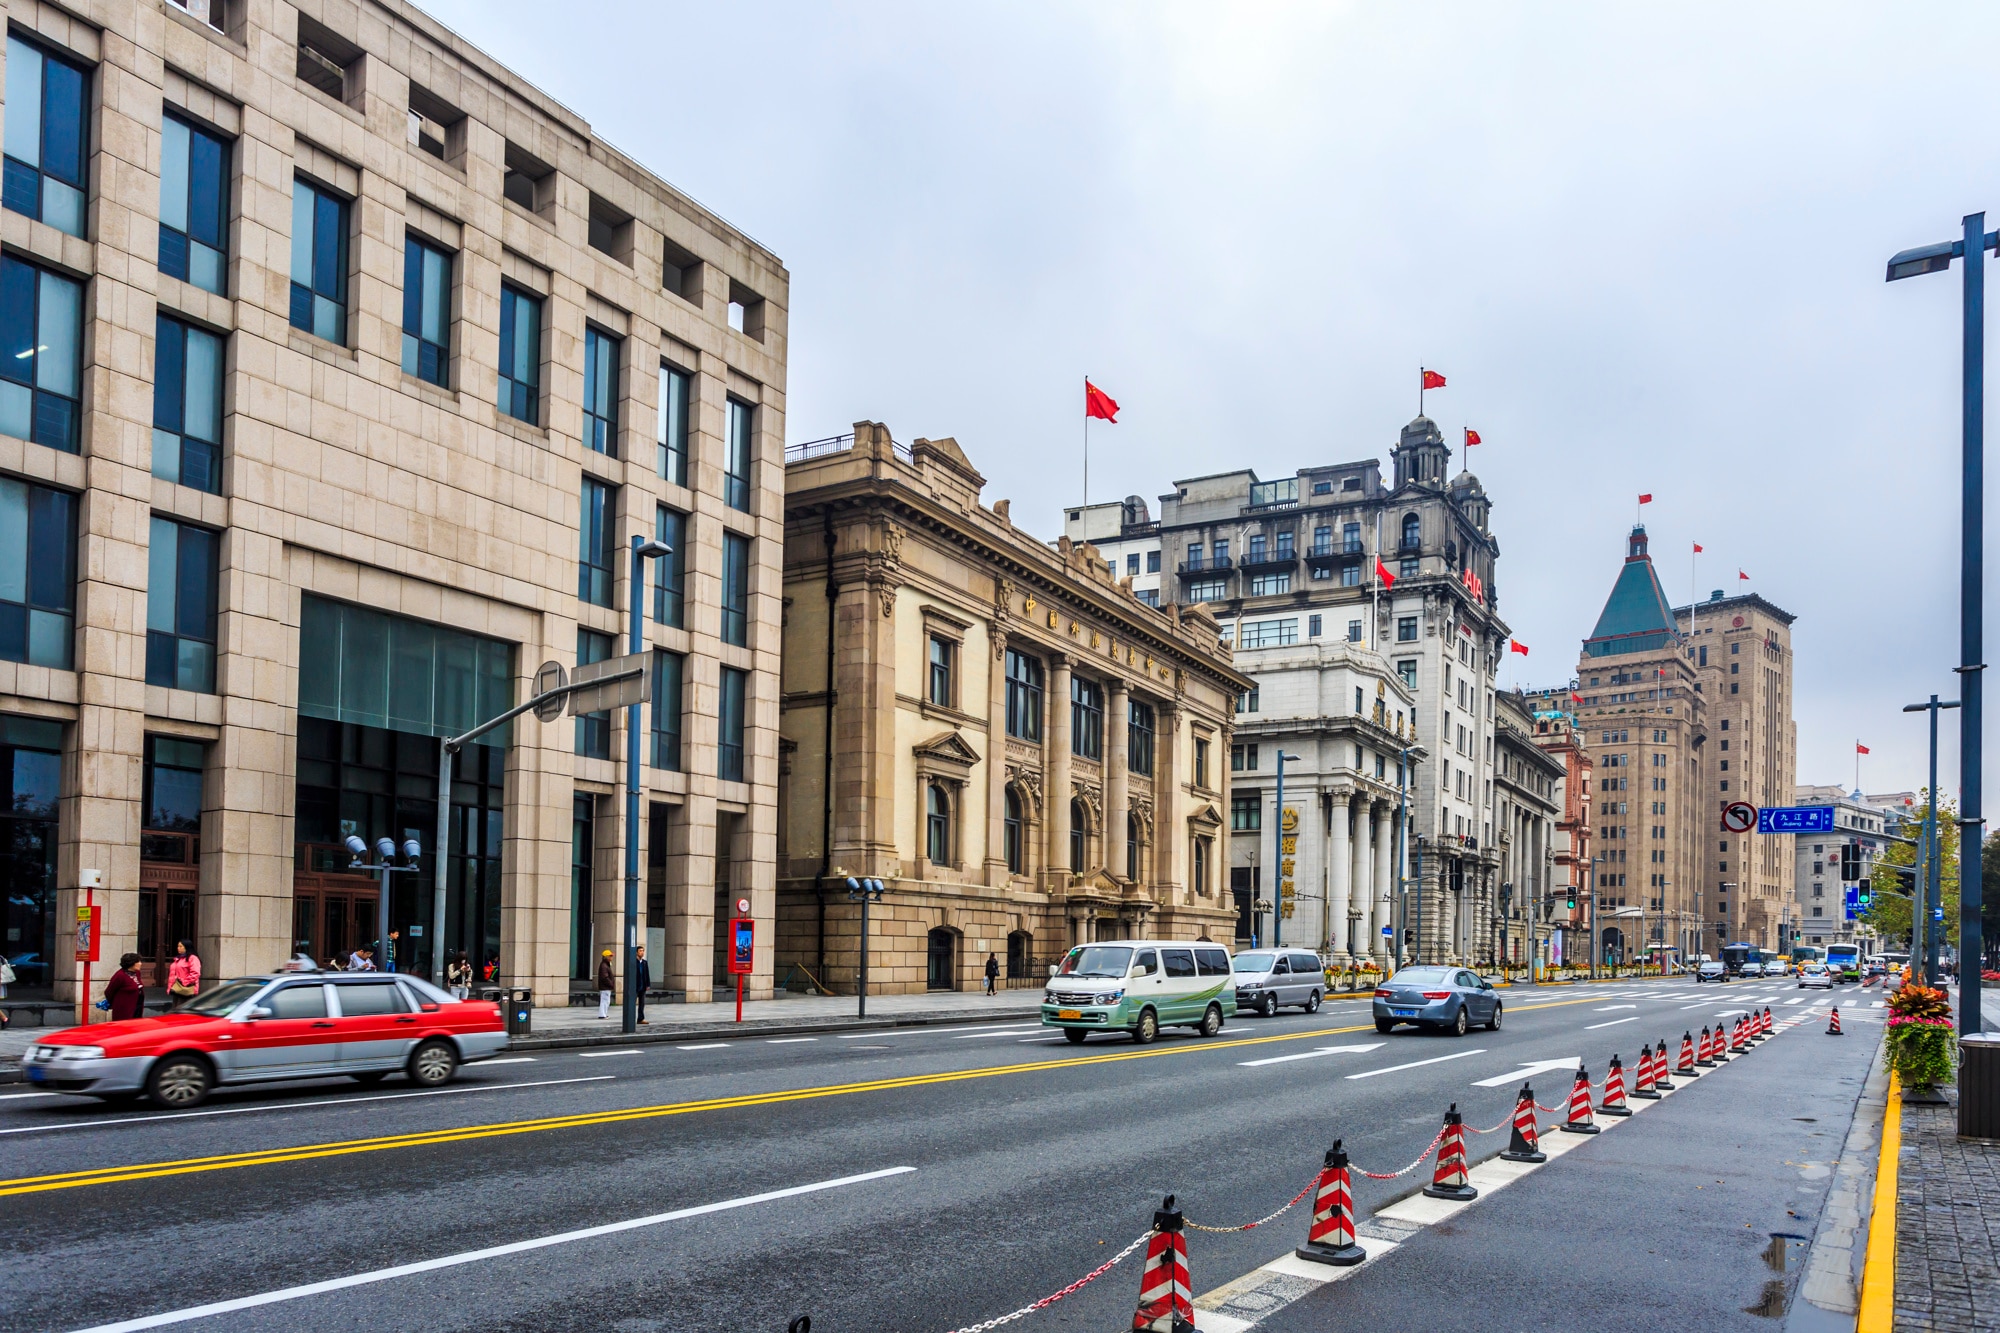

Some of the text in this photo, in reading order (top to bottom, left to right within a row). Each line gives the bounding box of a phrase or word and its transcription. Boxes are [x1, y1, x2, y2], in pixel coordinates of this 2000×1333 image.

[1463, 568, 1483, 605] AIA
[1780, 813, 1818, 821] 九江路
